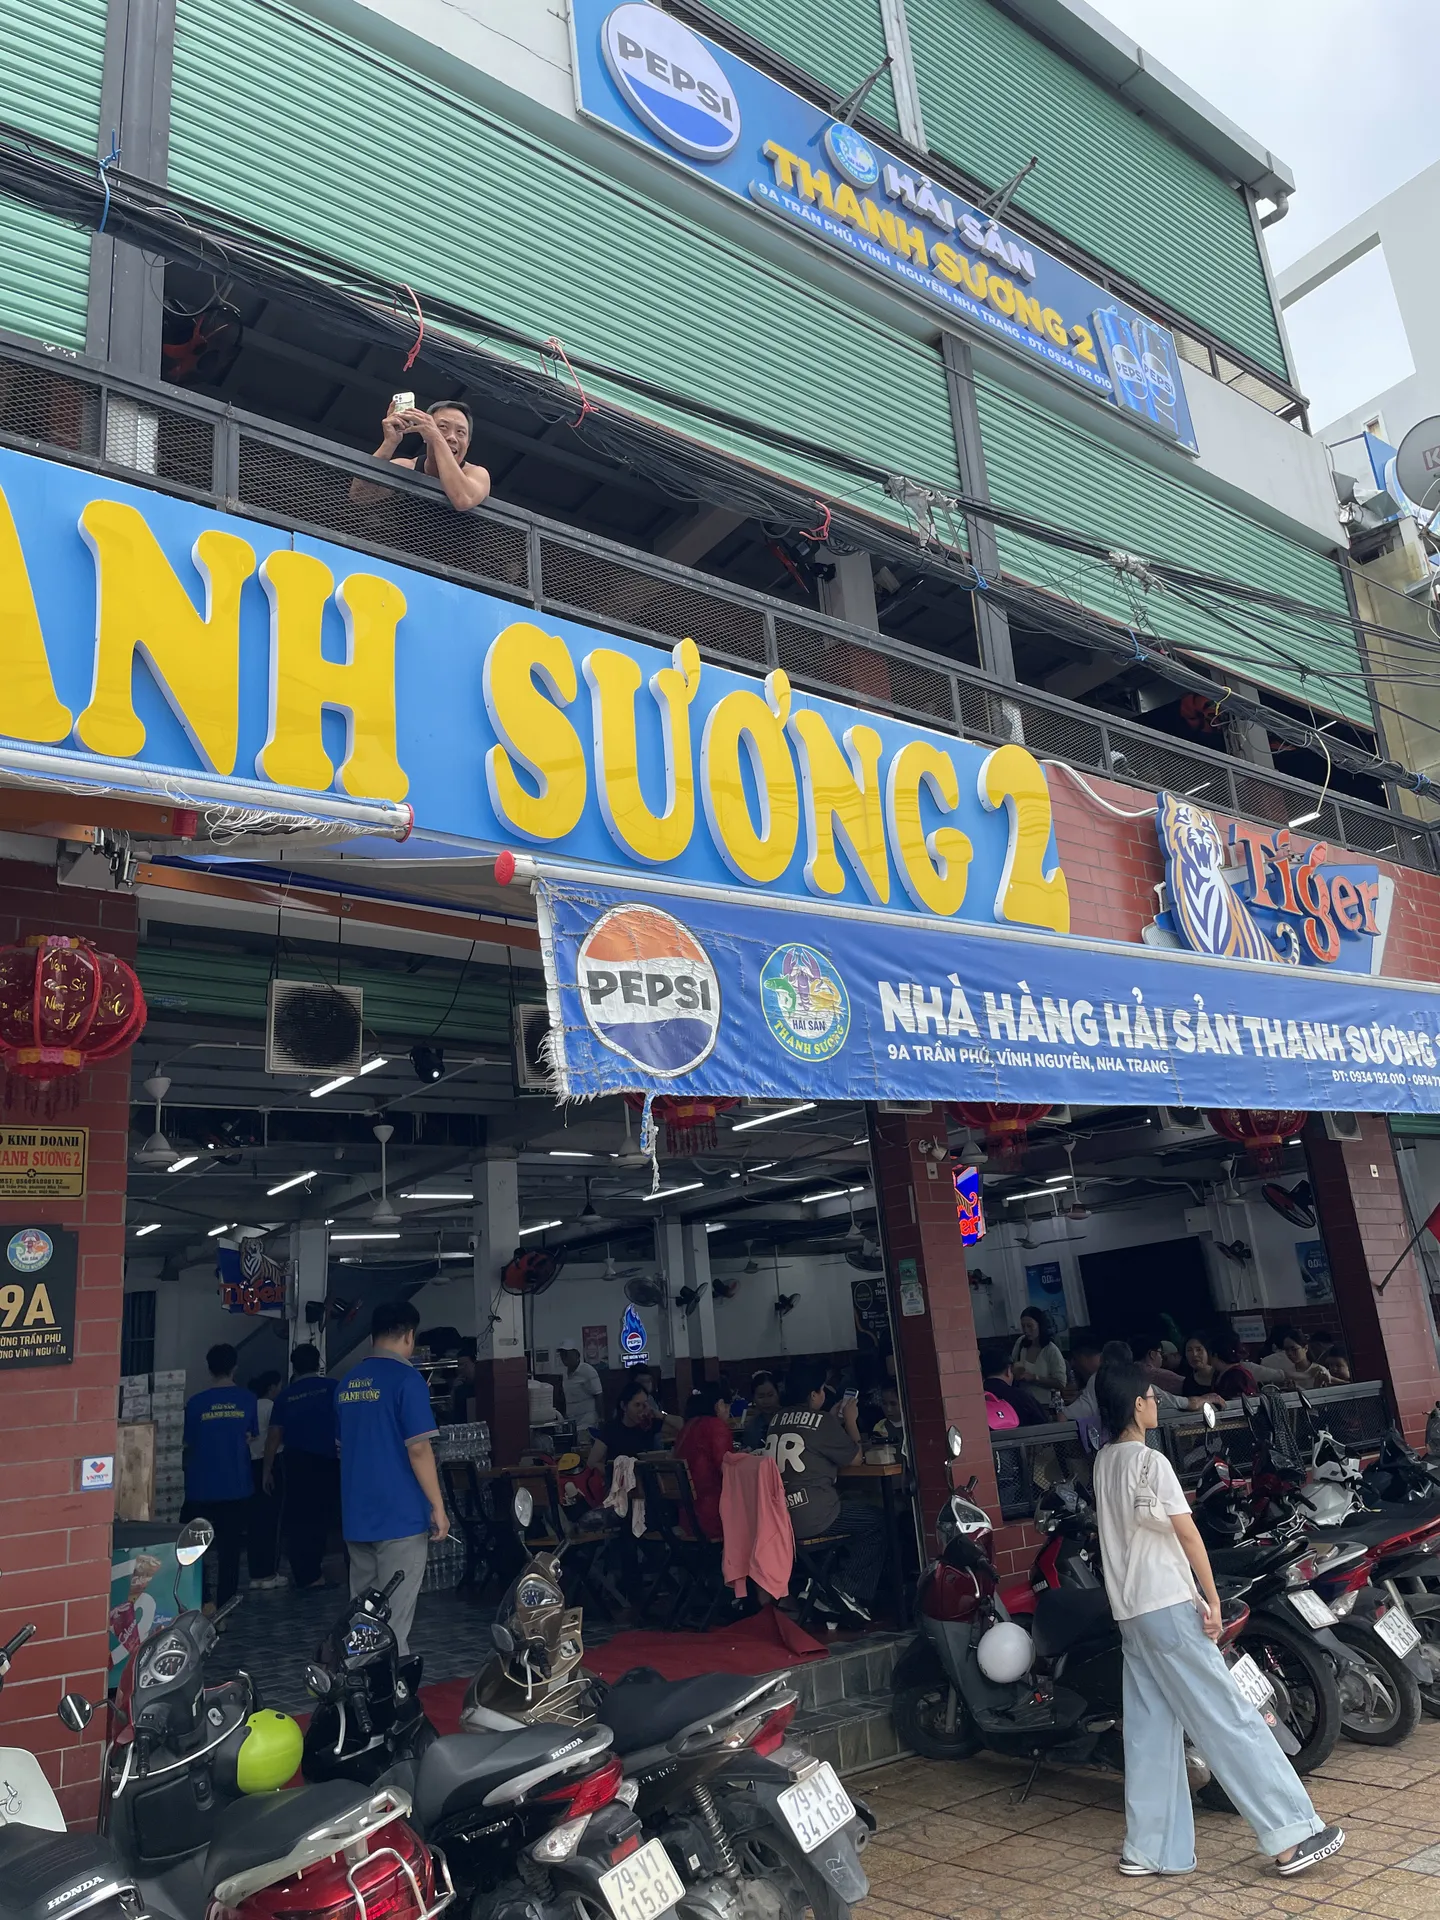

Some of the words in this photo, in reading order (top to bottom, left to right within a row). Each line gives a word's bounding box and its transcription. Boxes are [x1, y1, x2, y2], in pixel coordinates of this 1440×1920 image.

[617, 32, 733, 122] PEPSI
[884, 163, 956, 232] HẢI
[957, 213, 1036, 281] SẢN
[763, 139, 929, 270] THANH
[930, 242, 1069, 347] SƯƠNG
[1068, 324, 1098, 364] 2
[758, 183, 779, 202] 9A
[953, 293, 979, 317] NHA
[981, 309, 1021, 339] TRANG
[1047, 348, 1074, 370] 0934
[1075, 362, 1093, 380] 192
[1094, 374, 1113, 390] 010
[483, 622, 974, 916] SƯƠNG
[977, 744, 1071, 933] 2
[1229, 824, 1382, 963] Tiger
[585, 969, 712, 1011] PEPSI
[774, 1019, 812, 1056] THANH
[877, 973, 981, 1038] NHÀ
[983, 980, 1100, 1047] HÀNG
[1103, 986, 1170, 1051] HẢI
[1171, 993, 1244, 1056] SẢN
[1242, 1015, 1348, 1062] THANH
[1345, 1021, 1437, 1069] SƯƠNG
[887, 1043, 911, 1061] 9A
[912, 1040, 957, 1064] TRẦN
[996, 1048, 1033, 1068] VĨNH
[1035, 1051, 1095, 1073] NGUYÊN,
[1096, 1057, 1125, 1073] NHA
[1126, 1058, 1169, 1074] TRANG
[1331, 1069, 1349, 1083] ĐT:
[1349, 1070, 1373, 1083] 0934
[1373, 1071, 1390, 1084] 192
[1389, 1072, 1406, 1085] 010
[7, 1134, 36, 1146] KINH
[40, 1135, 79, 1147] DOANH
[74, 1151, 81, 1167] 2
[0, 1283, 56, 1328] 9A
[219, 1279, 287, 1315] Tiger
[780, 1412, 824, 1428] RABBIT
[1233, 1660, 1257, 1690] 9-H1
[551, 1737, 584, 1760] HONDA
[1313, 1839, 1341, 1861] crocs
[46, 1876, 105, 1911] HONDA
